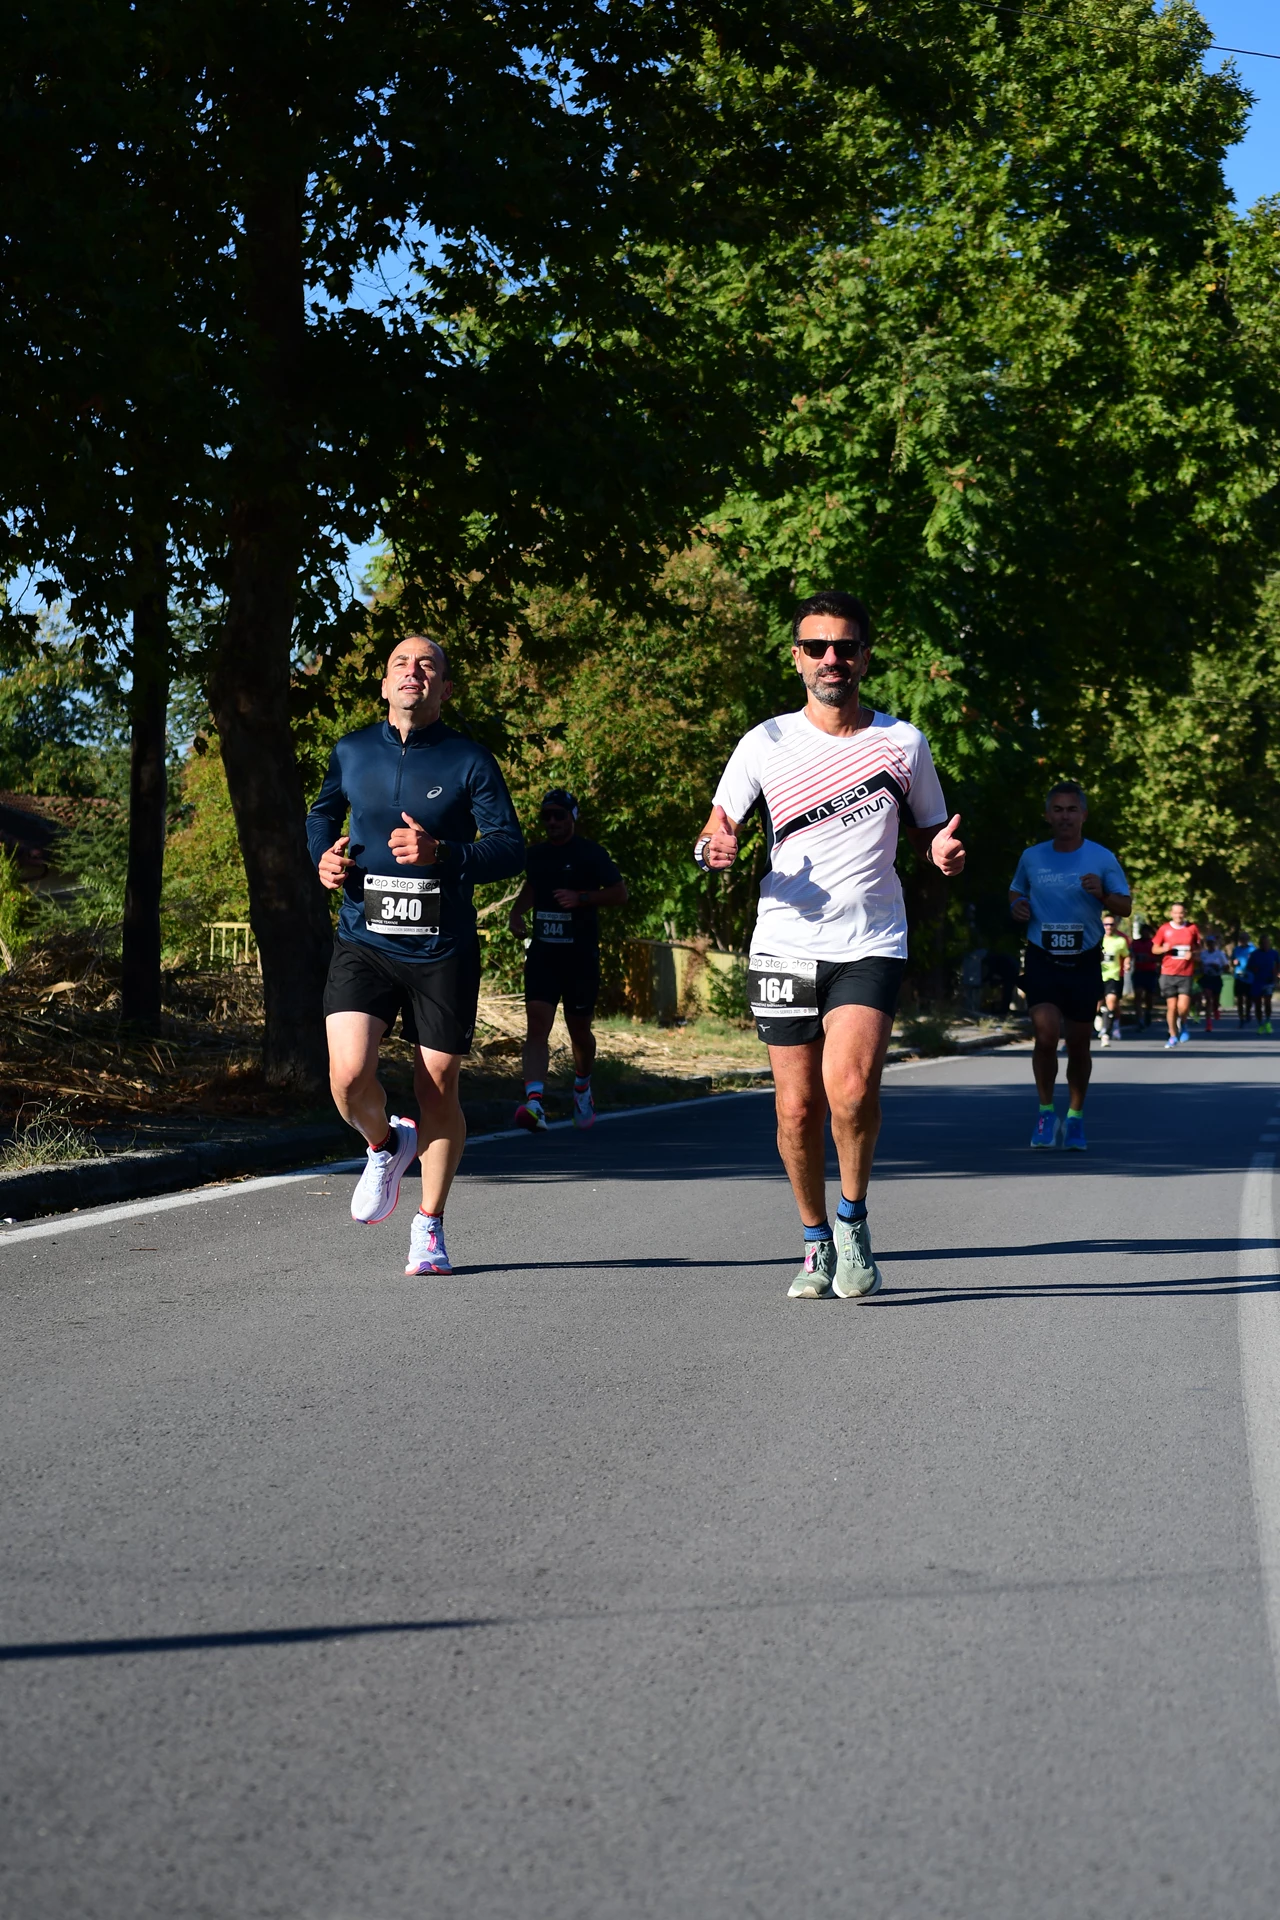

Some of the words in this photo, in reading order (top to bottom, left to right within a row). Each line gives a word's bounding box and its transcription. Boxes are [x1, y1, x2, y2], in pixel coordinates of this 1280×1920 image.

[805, 806, 830, 823] LA
[831, 784, 869, 812] SPO
[840, 796, 892, 827] RTIVA
[370, 876, 388, 890] tep
[391, 879, 415, 892] step
[381, 897, 422, 921] 340
[543, 922, 563, 935] 344
[1051, 934, 1075, 947] 365
[765, 958, 788, 972] step
[792, 960, 815, 971] step
[758, 977, 794, 1002] 164
